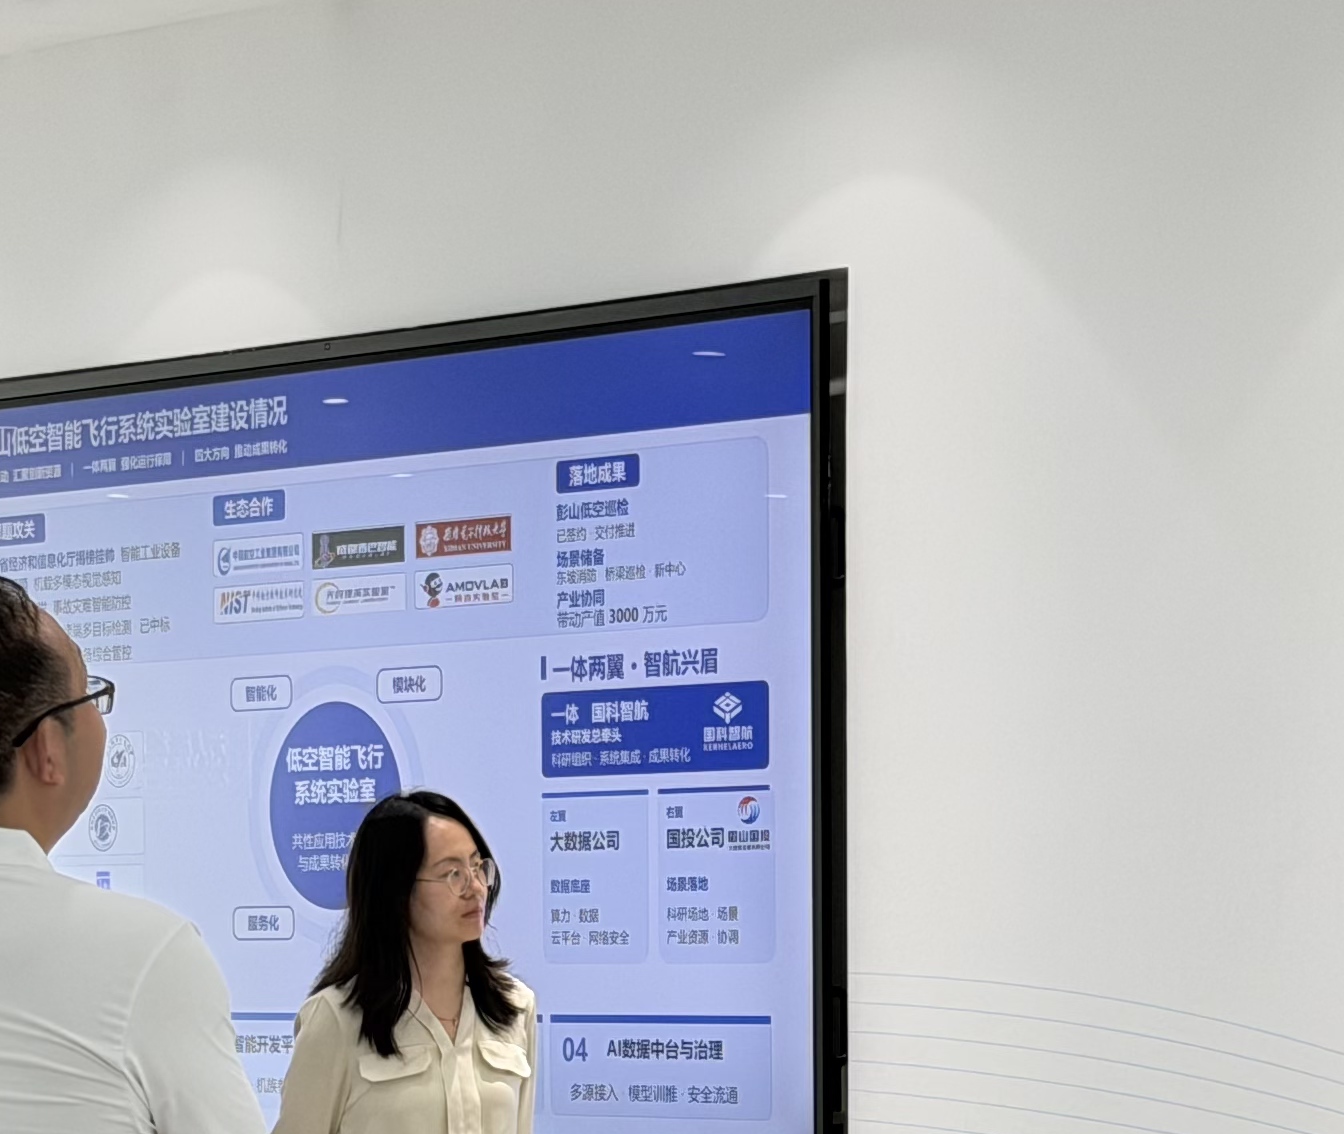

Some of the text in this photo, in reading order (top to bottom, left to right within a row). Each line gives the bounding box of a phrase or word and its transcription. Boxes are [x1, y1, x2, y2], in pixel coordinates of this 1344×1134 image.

[569, 461, 626, 487] 落地成果
[224, 497, 274, 519] 生态合作
[556, 498, 629, 521] 彭山低空巡检
[556, 522, 635, 543] 已签约 交付推进
[556, 548, 604, 568] 场景储备
[654, 561, 686, 578] 新中心
[446, 578, 509, 593] AMOVLAB
[556, 589, 605, 608] 产业协同
[556, 605, 668, 628] 带动产值 3000 万元
[245, 684, 277, 703] 智能化
[392, 676, 426, 694] 模块化
[551, 700, 649, 725] 一体 国科智航
[551, 727, 622, 746] 技术研发总牵头
[703, 725, 754, 742] 国科智航
[286, 744, 384, 773] 低空智能飞行
[294, 777, 377, 806] 系统实验室
[550, 830, 620, 851] 大数据公司
[666, 827, 725, 849] 国投公司
[666, 876, 708, 892] 场景落地
[551, 908, 599, 923] 算力 数据
[666, 906, 709, 922] 科研场地
[551, 930, 629, 945] 云平台 网络安全
[666, 929, 709, 945] 产业资源
[562, 1037, 724, 1062] 04 AI数据中台与治理
[570, 1084, 619, 1101] 多源接入
[687, 1085, 739, 1104] 安全流通
